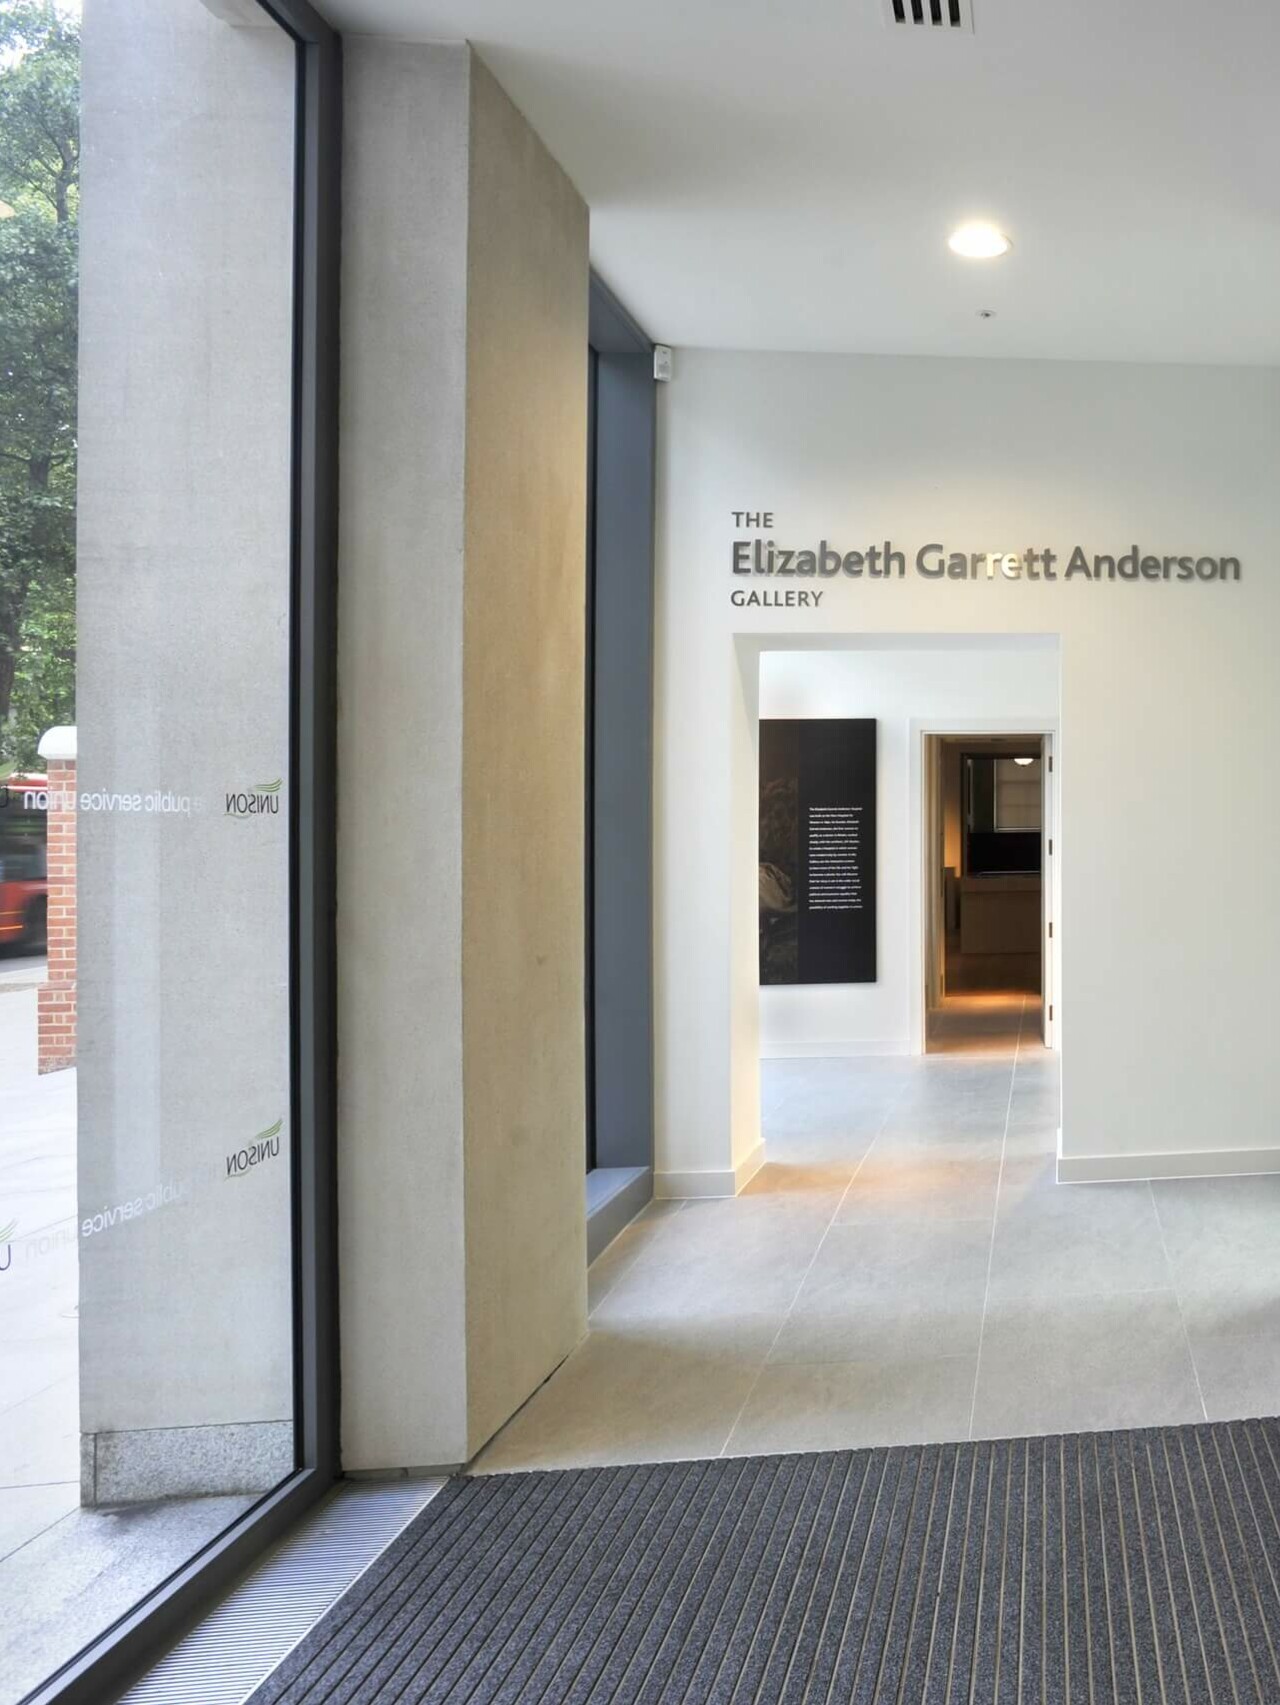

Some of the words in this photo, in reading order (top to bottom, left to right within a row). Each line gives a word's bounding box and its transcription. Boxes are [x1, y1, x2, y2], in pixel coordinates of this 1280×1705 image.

[732, 512, 774, 528] THE
[731, 540, 906, 578] Elizabeth
[915, 544, 1057, 580] Garrett
[1065, 545, 1241, 581] Anderson
[731, 591, 823, 607] GALLERY
